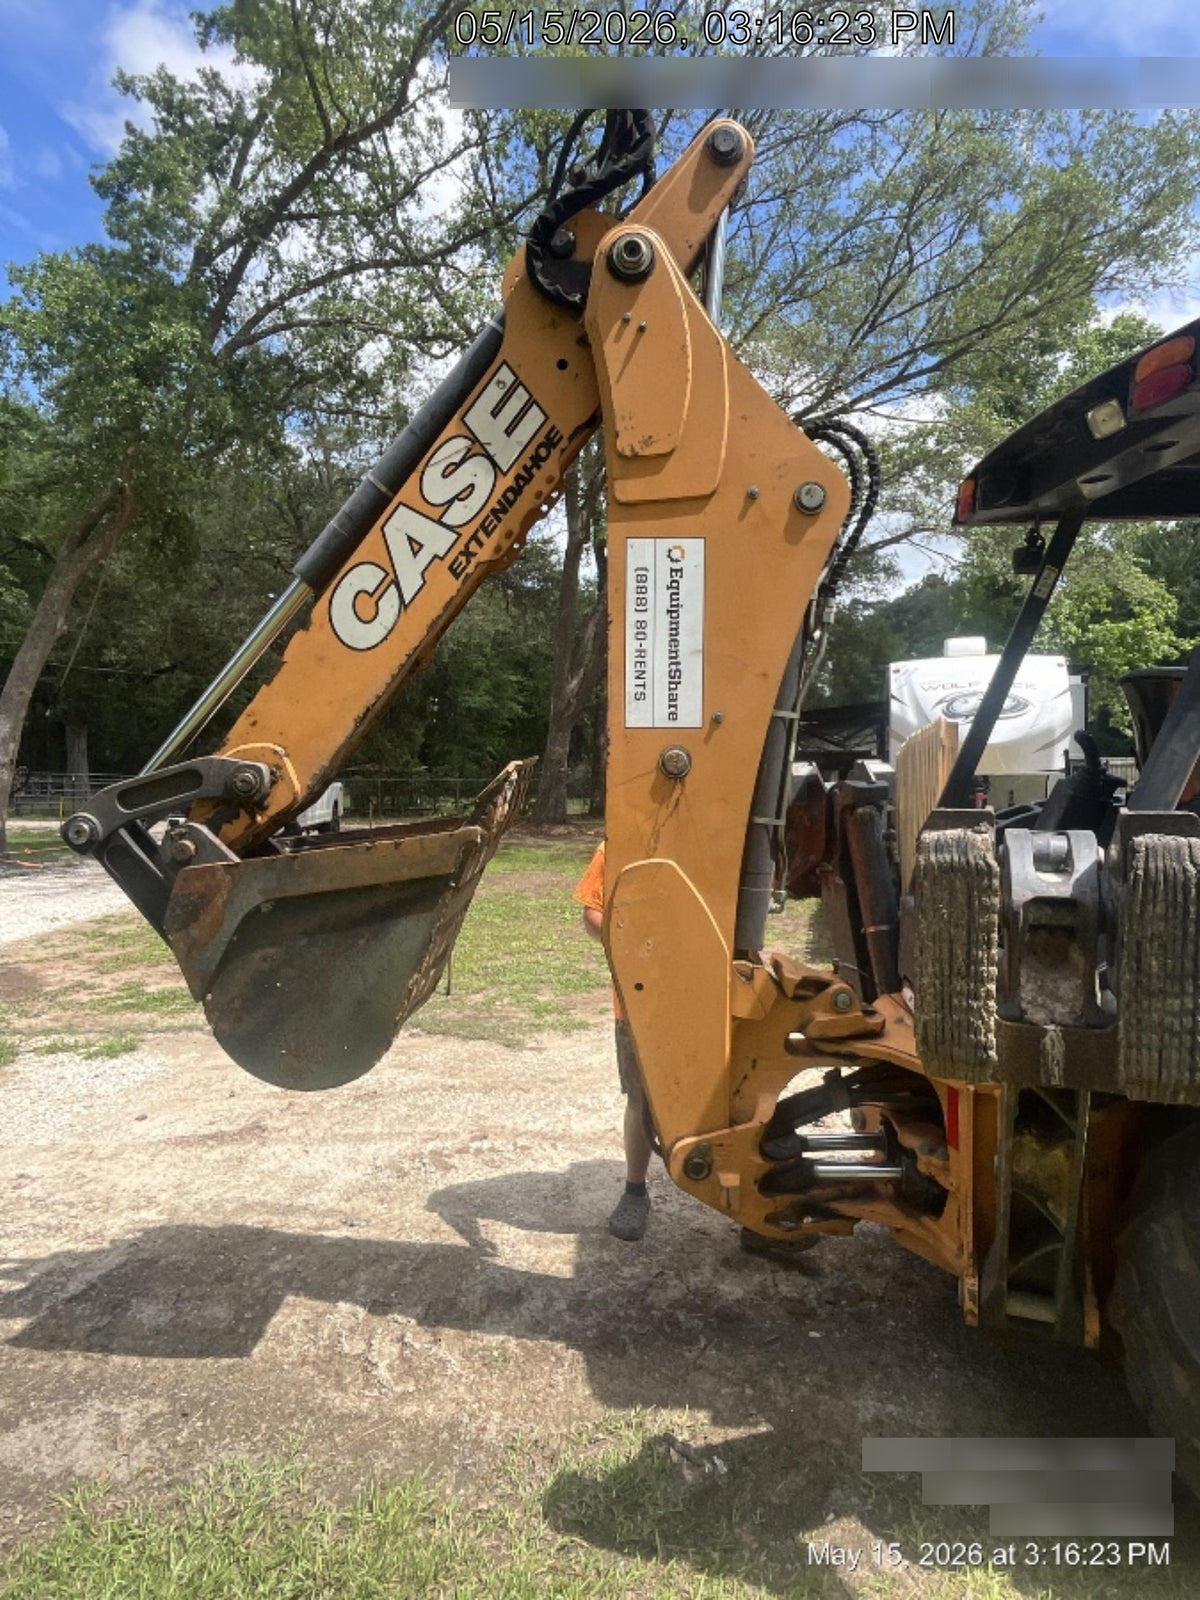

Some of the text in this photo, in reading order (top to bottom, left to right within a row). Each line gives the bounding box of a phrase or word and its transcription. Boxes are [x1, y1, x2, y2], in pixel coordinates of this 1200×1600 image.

[328, 359, 549, 651] CASE
[447, 425, 564, 580] EXTENDAHOE
[634, 566, 649, 701] (888) 80-RENTS
[666, 567, 683, 721] EquipmentShare
